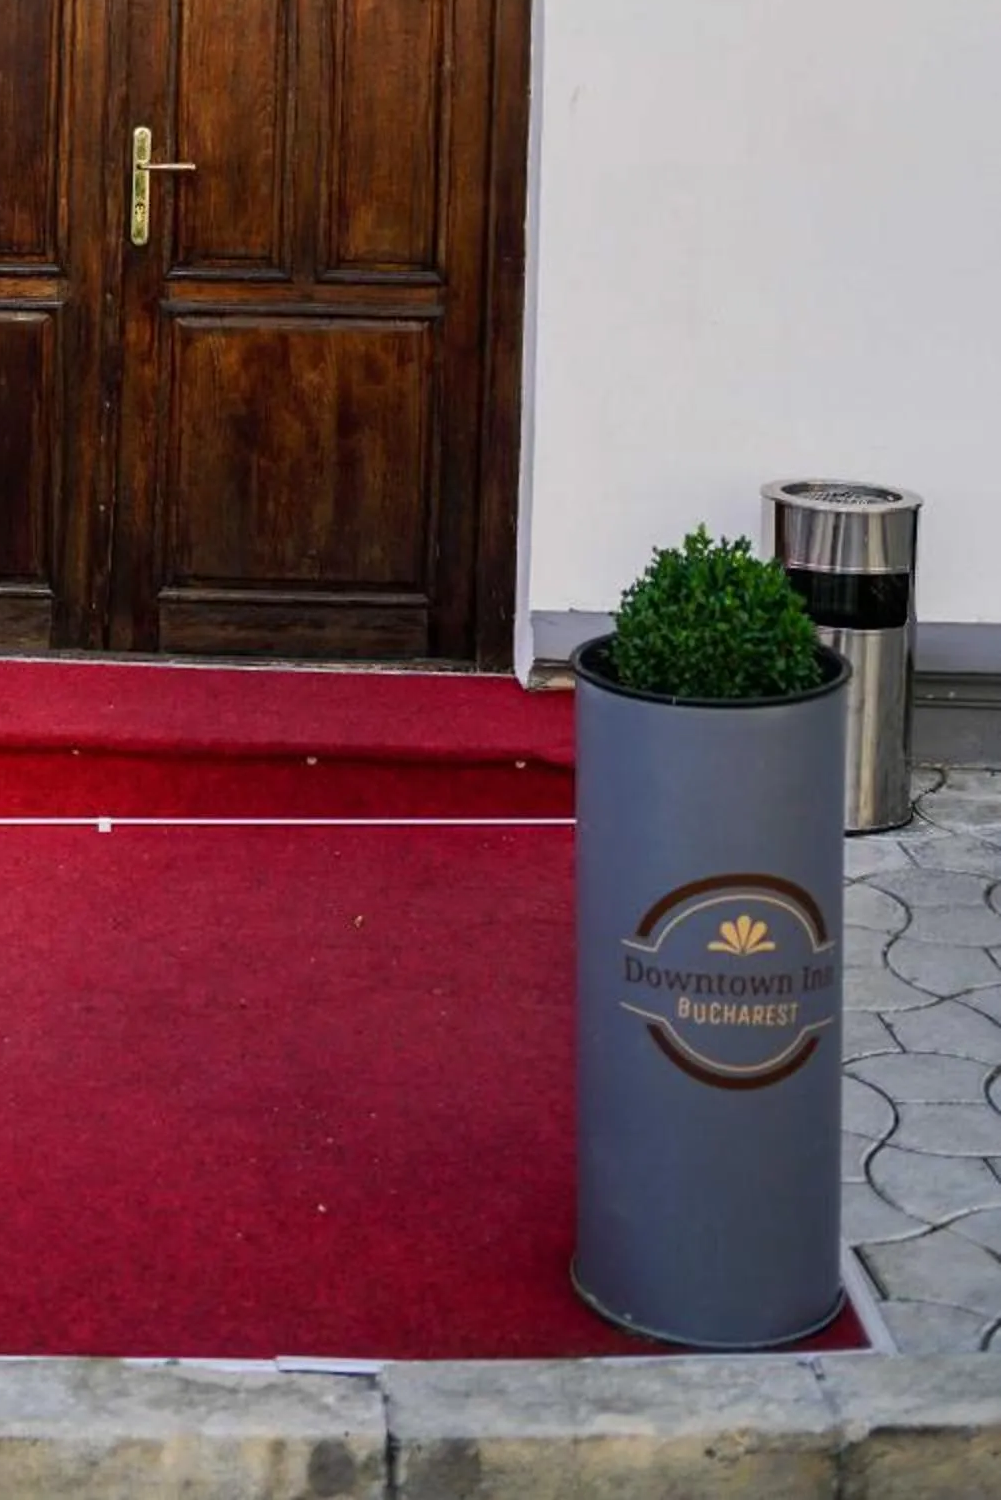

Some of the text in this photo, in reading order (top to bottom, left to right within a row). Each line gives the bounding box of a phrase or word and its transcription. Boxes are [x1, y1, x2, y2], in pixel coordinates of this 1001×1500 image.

[624, 955, 835, 996] Downtown Inn
[677, 996, 799, 1026] BUCHAREST
